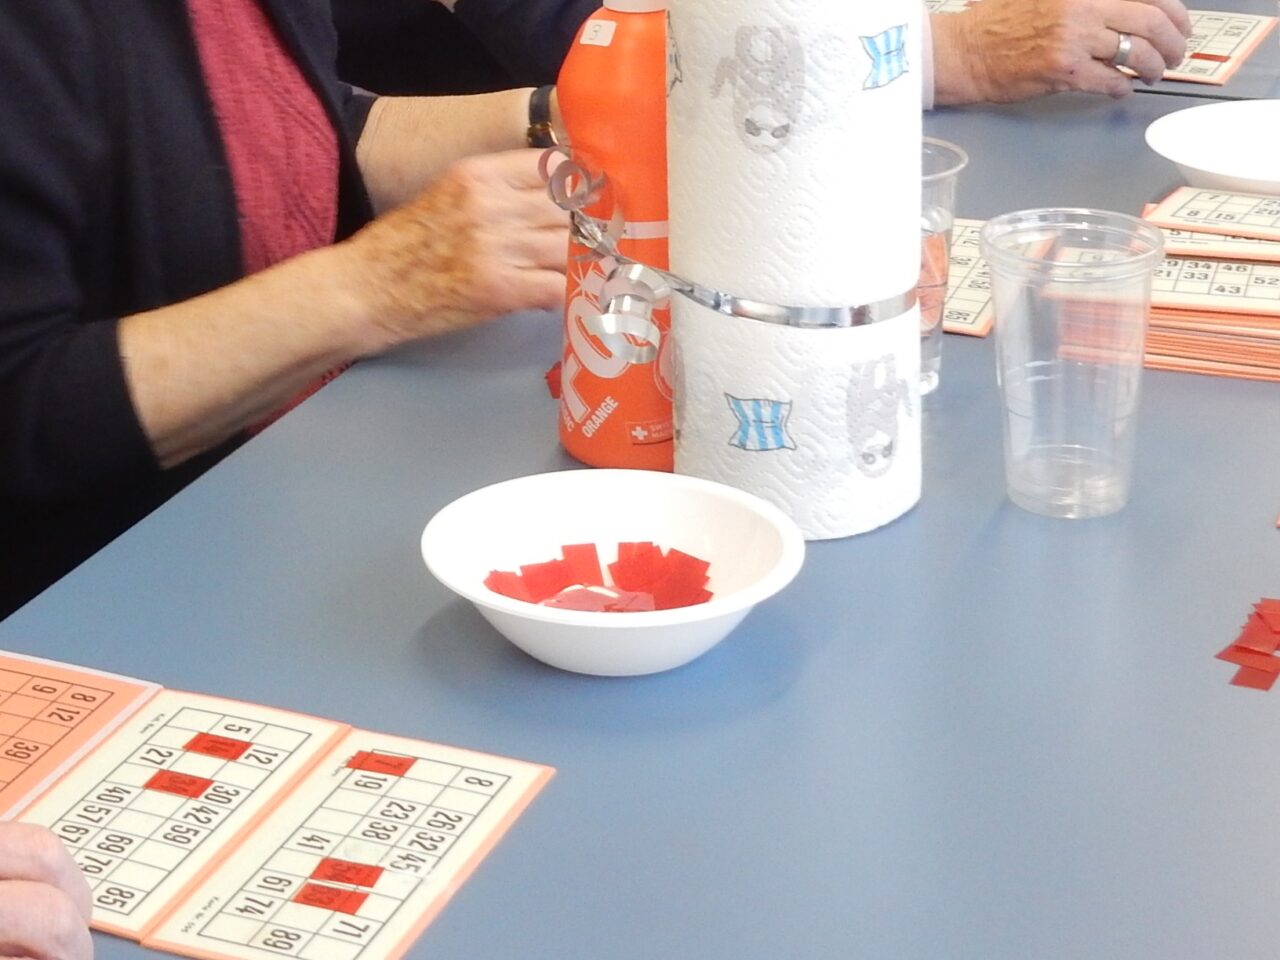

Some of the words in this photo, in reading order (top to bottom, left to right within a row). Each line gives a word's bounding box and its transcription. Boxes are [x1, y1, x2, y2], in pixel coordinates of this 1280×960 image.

[1183, 271, 1209, 281] 33
[1253, 276, 1280, 286] 52
[1214, 285, 1241, 294] 43
[582, 396, 619, 438] ORANGE
[32, 683, 58, 695] 9
[71, 692, 97, 703] 8
[47, 707, 81, 722] 12
[224, 722, 253, 735] 5
[4, 741, 40, 760] 39
[140, 747, 174, 766] 27
[245, 748, 279, 765] 12
[354, 774, 388, 790] 19
[464, 776, 494, 788] 8
[96, 785, 132, 804] 40
[204, 785, 241, 805] 30
[76, 804, 112, 824] 57
[182, 805, 220, 825] 42
[380, 800, 417, 820] 23
[426, 810, 463, 831] 26
[58, 824, 91, 844] 67
[163, 824, 201, 844] 59
[361, 821, 398, 841] 38
[97, 834, 134, 854] 69
[297, 833, 332, 851] 41
[407, 830, 446, 852] 32
[78, 855, 113, 875] 79
[389, 852, 427, 873] 45
[256, 875, 293, 893] 61
[96, 886, 136, 908] 85
[235, 896, 275, 916] 74
[332, 920, 370, 939] 71
[263, 928, 302, 951] 89
